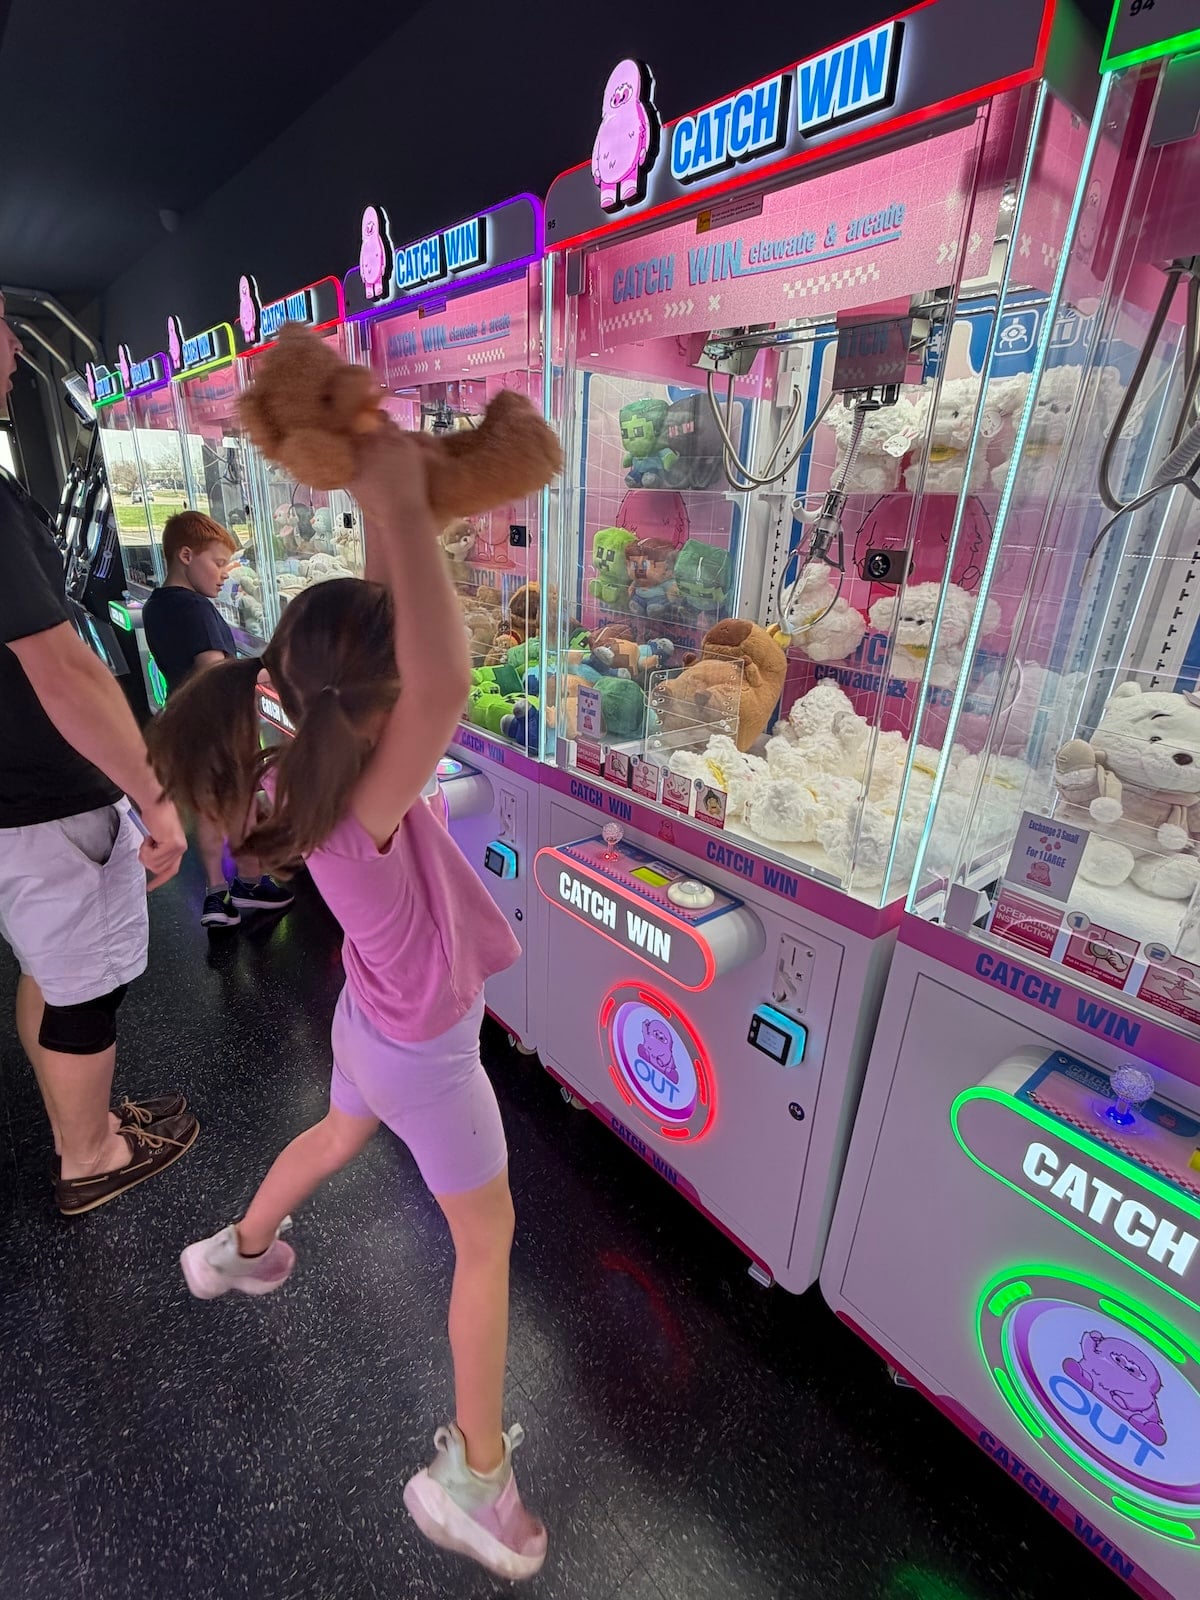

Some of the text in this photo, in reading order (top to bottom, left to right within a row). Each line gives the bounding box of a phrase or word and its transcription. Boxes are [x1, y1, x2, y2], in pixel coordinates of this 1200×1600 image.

[673, 29, 889, 174] CATCH WIN
[547, 219, 556, 230] 95
[396, 222, 477, 285] CATCH WIN
[612, 202, 906, 304] CATCH WIN clawade & arcade
[261, 293, 306, 335] CATCH WIN
[421, 324, 448, 353] WIN
[461, 731, 504, 763] CATCH WIN
[570, 779, 603, 807] CATCH
[609, 796, 632, 821] WIN
[1029, 819, 1080, 844] Exchange 3 Small
[706, 840, 798, 898] CATCH WIN
[1026, 846, 1039, 858] For
[1043, 851, 1067, 868] LARGE
[559, 871, 671, 964] CATCH WIN
[996, 912, 1055, 941] INSTRUCTION
[998, 904, 1057, 935] OPERATION
[1074, 916, 1084, 928] 1
[975, 953, 1062, 1009] CATCH
[1076, 997, 1142, 1047] WIN
[634, 1058, 680, 1103] OUT
[611, 1117, 678, 1185] CATCH WIN
[1022, 1142, 1199, 1277] CATCH
[1048, 1375, 1165, 1467] OUT
[978, 1430, 1135, 1580] CATCH WIN
